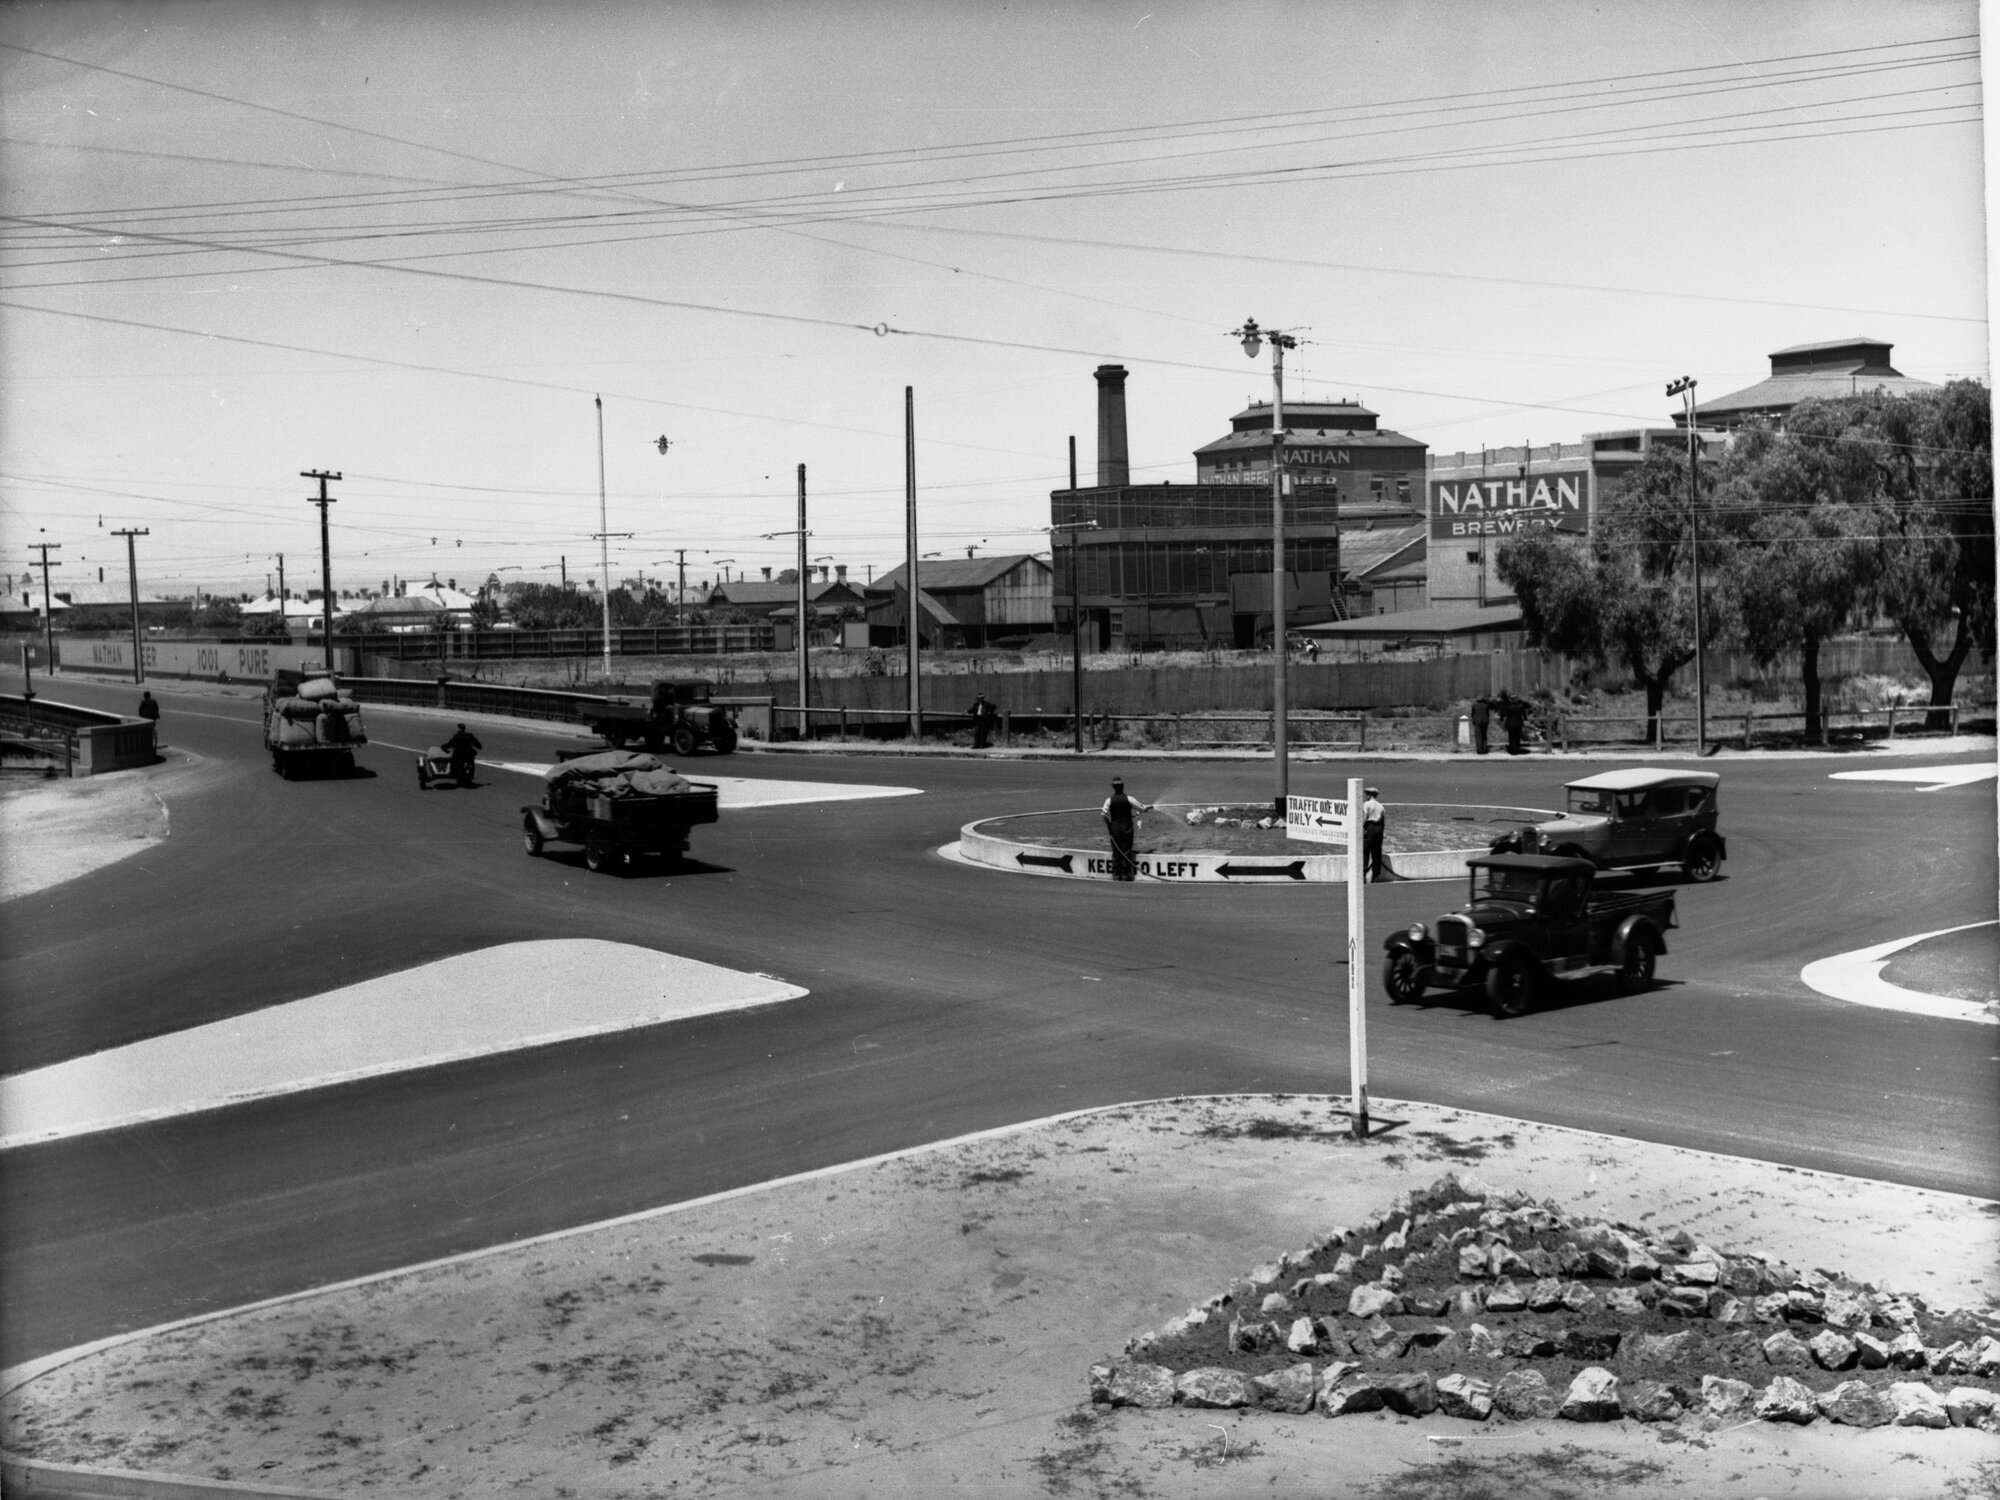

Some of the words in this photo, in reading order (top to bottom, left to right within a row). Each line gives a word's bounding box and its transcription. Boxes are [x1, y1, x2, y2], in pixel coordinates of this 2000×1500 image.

[1439, 476, 1580, 516] NATHAN
[239, 648, 269, 675] PURE
[1289, 797, 1318, 813] TRAFFIC
[1319, 800, 1333, 814] ONE
[1334, 803, 1348, 816] WAY
[1289, 811, 1312, 826] ONLY
[1088, 858, 1113, 875] KEE
[1156, 861, 1199, 878] LEFT
